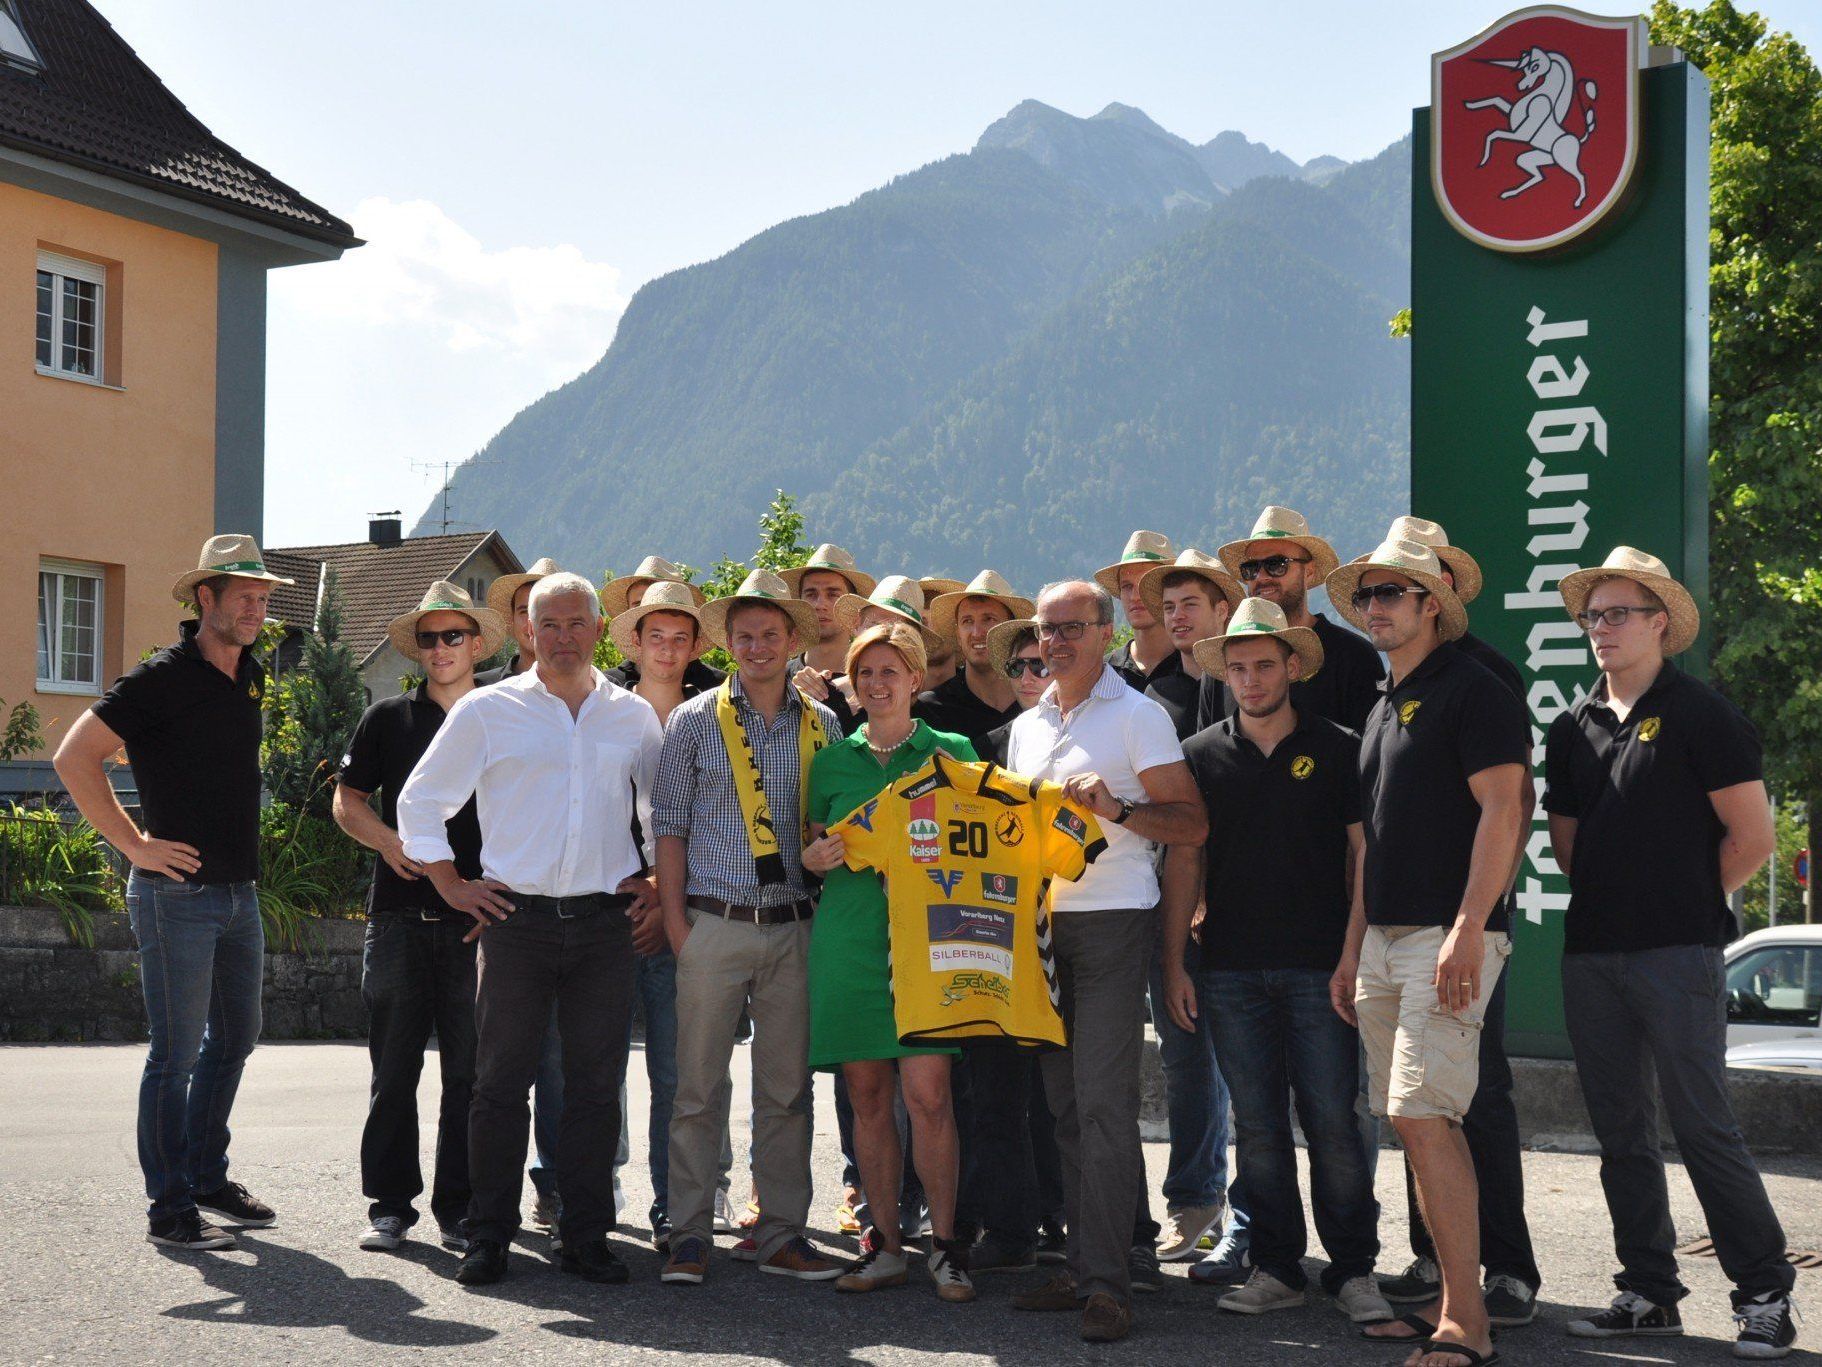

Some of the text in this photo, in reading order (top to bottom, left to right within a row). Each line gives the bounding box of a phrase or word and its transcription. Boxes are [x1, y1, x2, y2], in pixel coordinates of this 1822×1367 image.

[1504, 304, 1608, 926] foenburger
[908, 778, 938, 799] hummel
[947, 819, 989, 859] 20
[909, 844, 942, 858] Kaiser
[960, 909, 993, 922] Vorarlberg
[932, 949, 1003, 965] SILBERBALL
